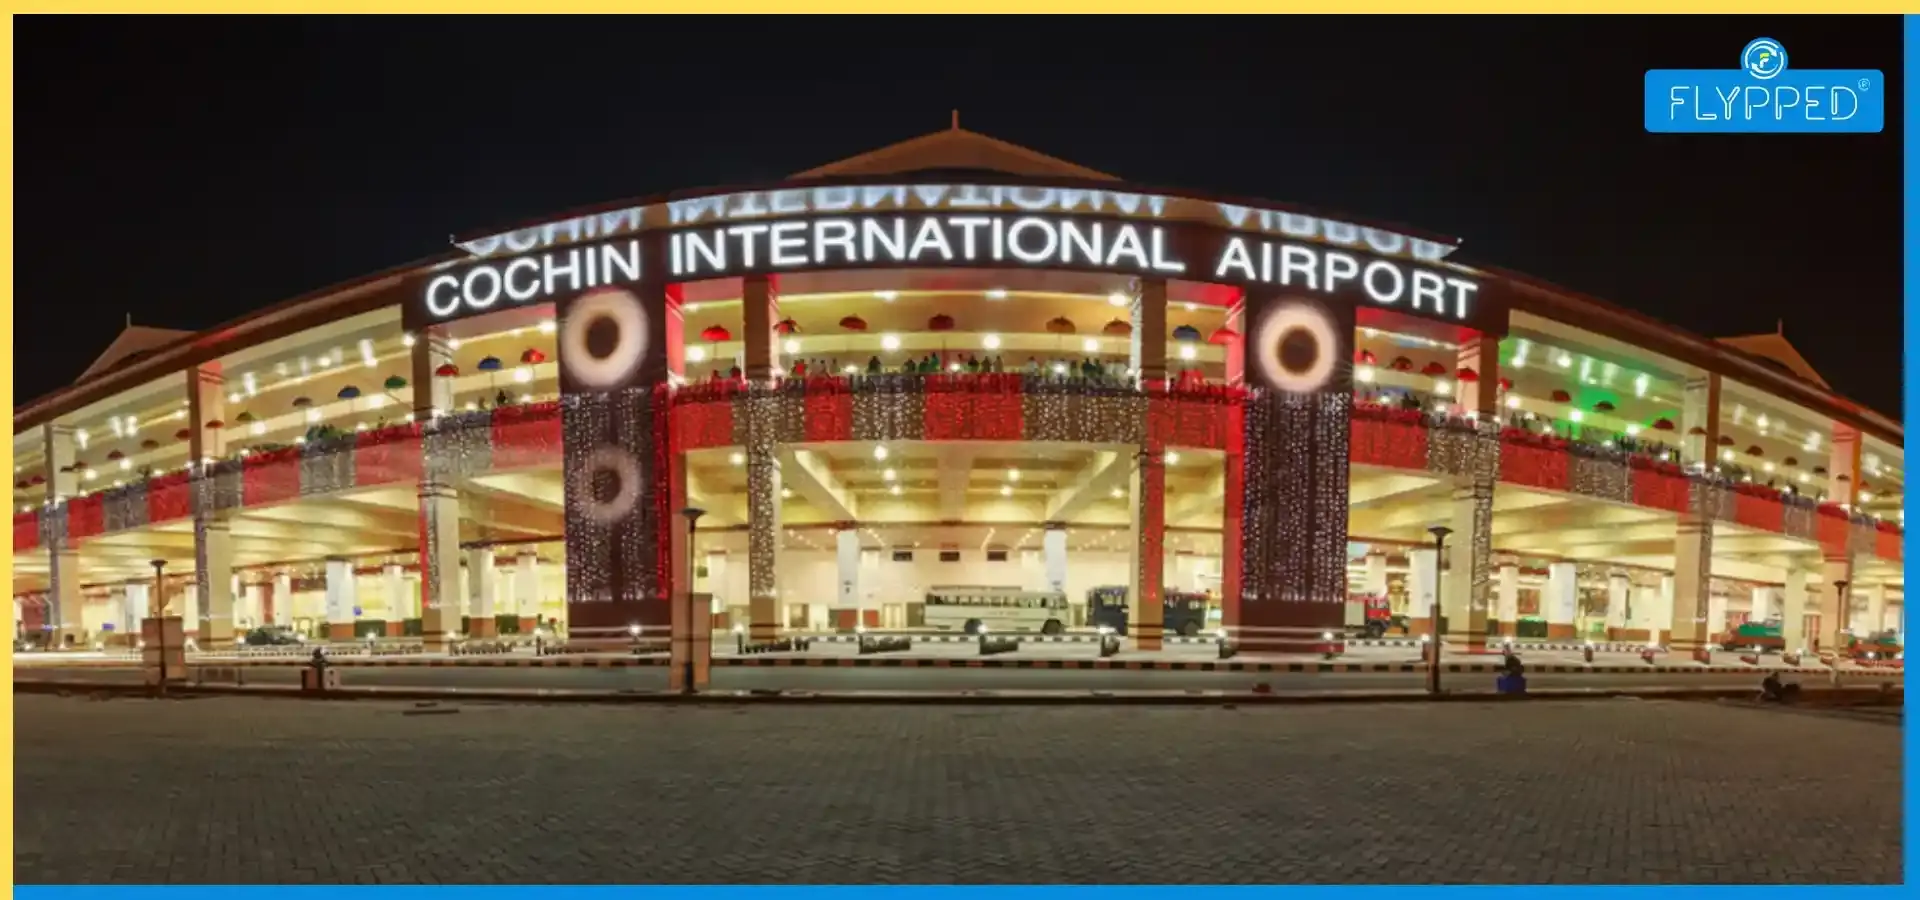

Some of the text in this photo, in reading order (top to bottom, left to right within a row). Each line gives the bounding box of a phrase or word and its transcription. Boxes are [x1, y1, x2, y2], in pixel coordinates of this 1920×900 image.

[426, 238, 640, 316] COCHIN
[670, 217, 1185, 275] INTERNATIONAL
[1216, 237, 1478, 319] AIRPORT
